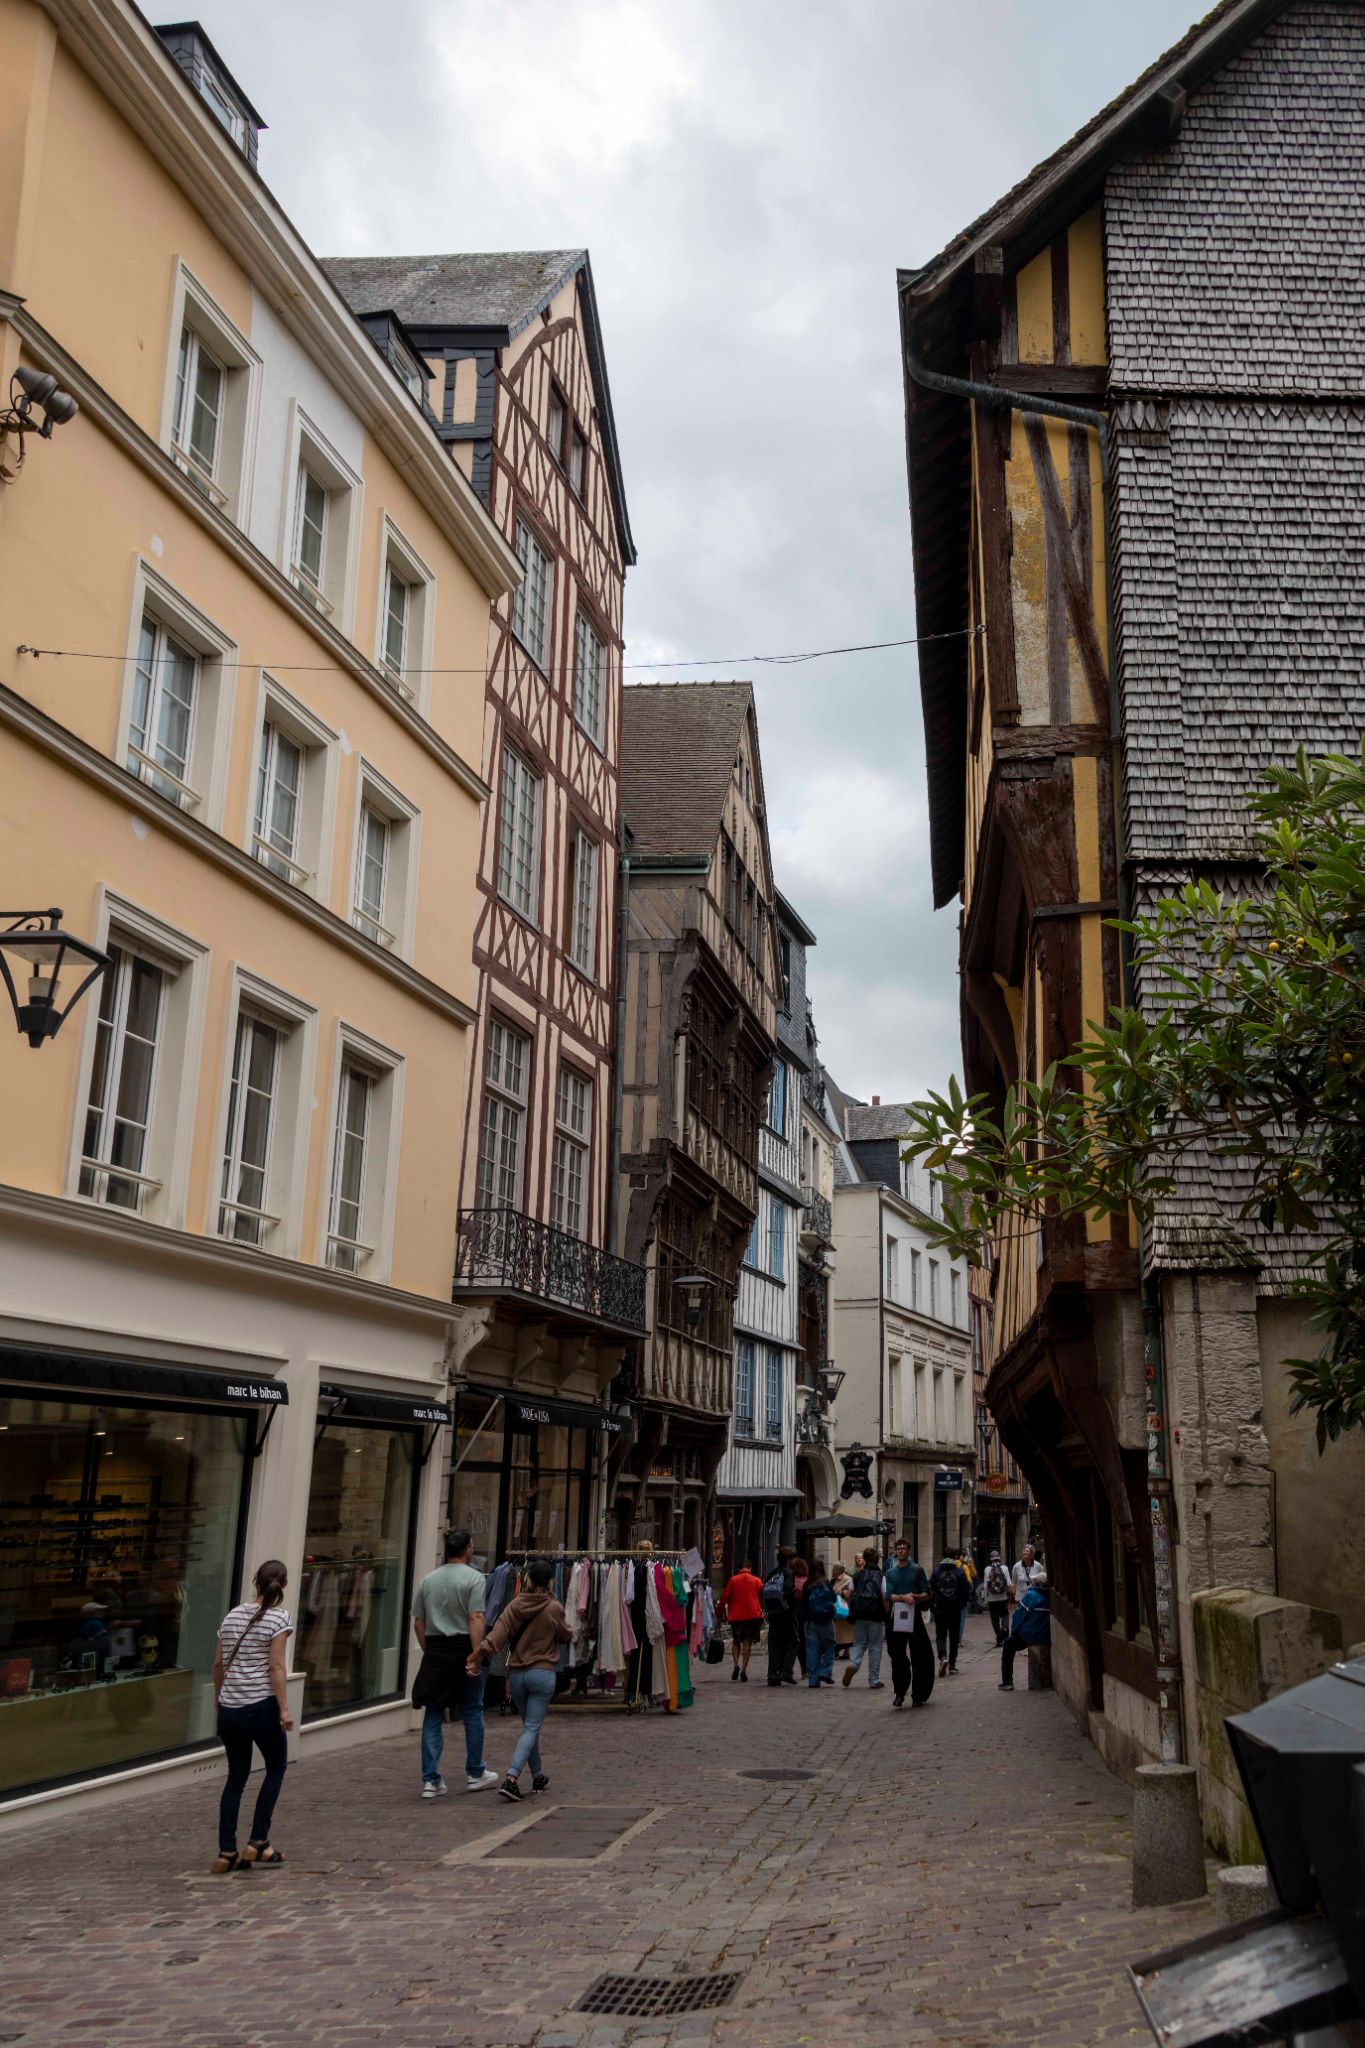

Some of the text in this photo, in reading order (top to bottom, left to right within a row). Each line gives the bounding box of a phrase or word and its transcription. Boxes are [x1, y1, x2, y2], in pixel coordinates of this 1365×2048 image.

[227, 1385, 282, 1399] marc le bihan
